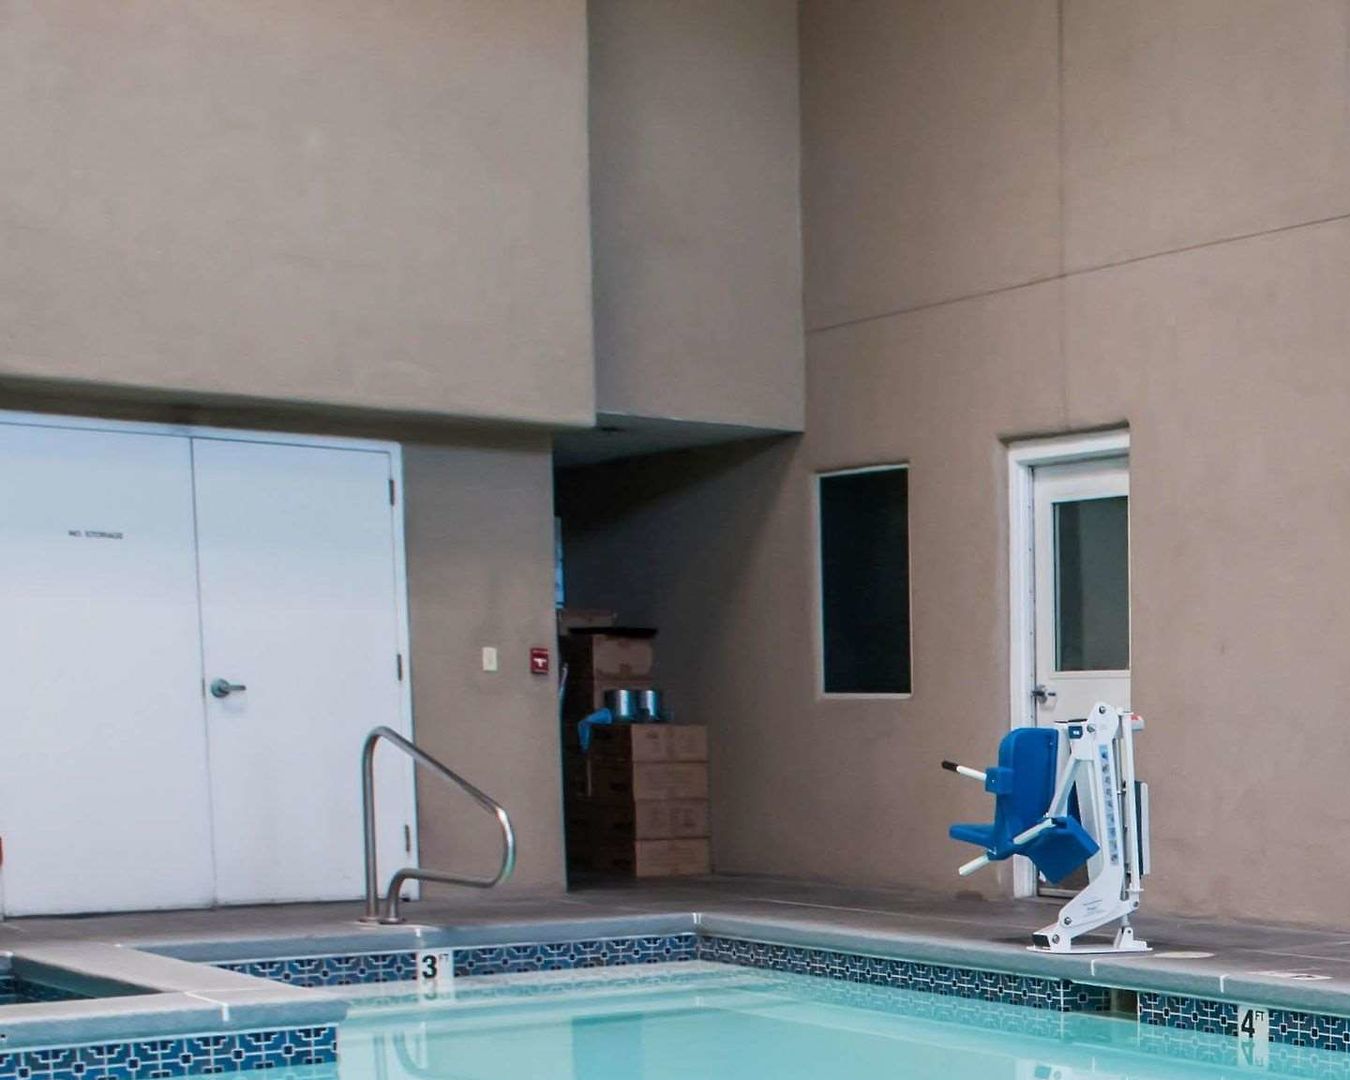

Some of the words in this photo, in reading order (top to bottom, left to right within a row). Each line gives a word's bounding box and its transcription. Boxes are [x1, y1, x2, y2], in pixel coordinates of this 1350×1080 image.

[422, 954, 437, 978] 3
[1241, 1009, 1256, 1038] 4
[1255, 1010, 1265, 1021] FT
